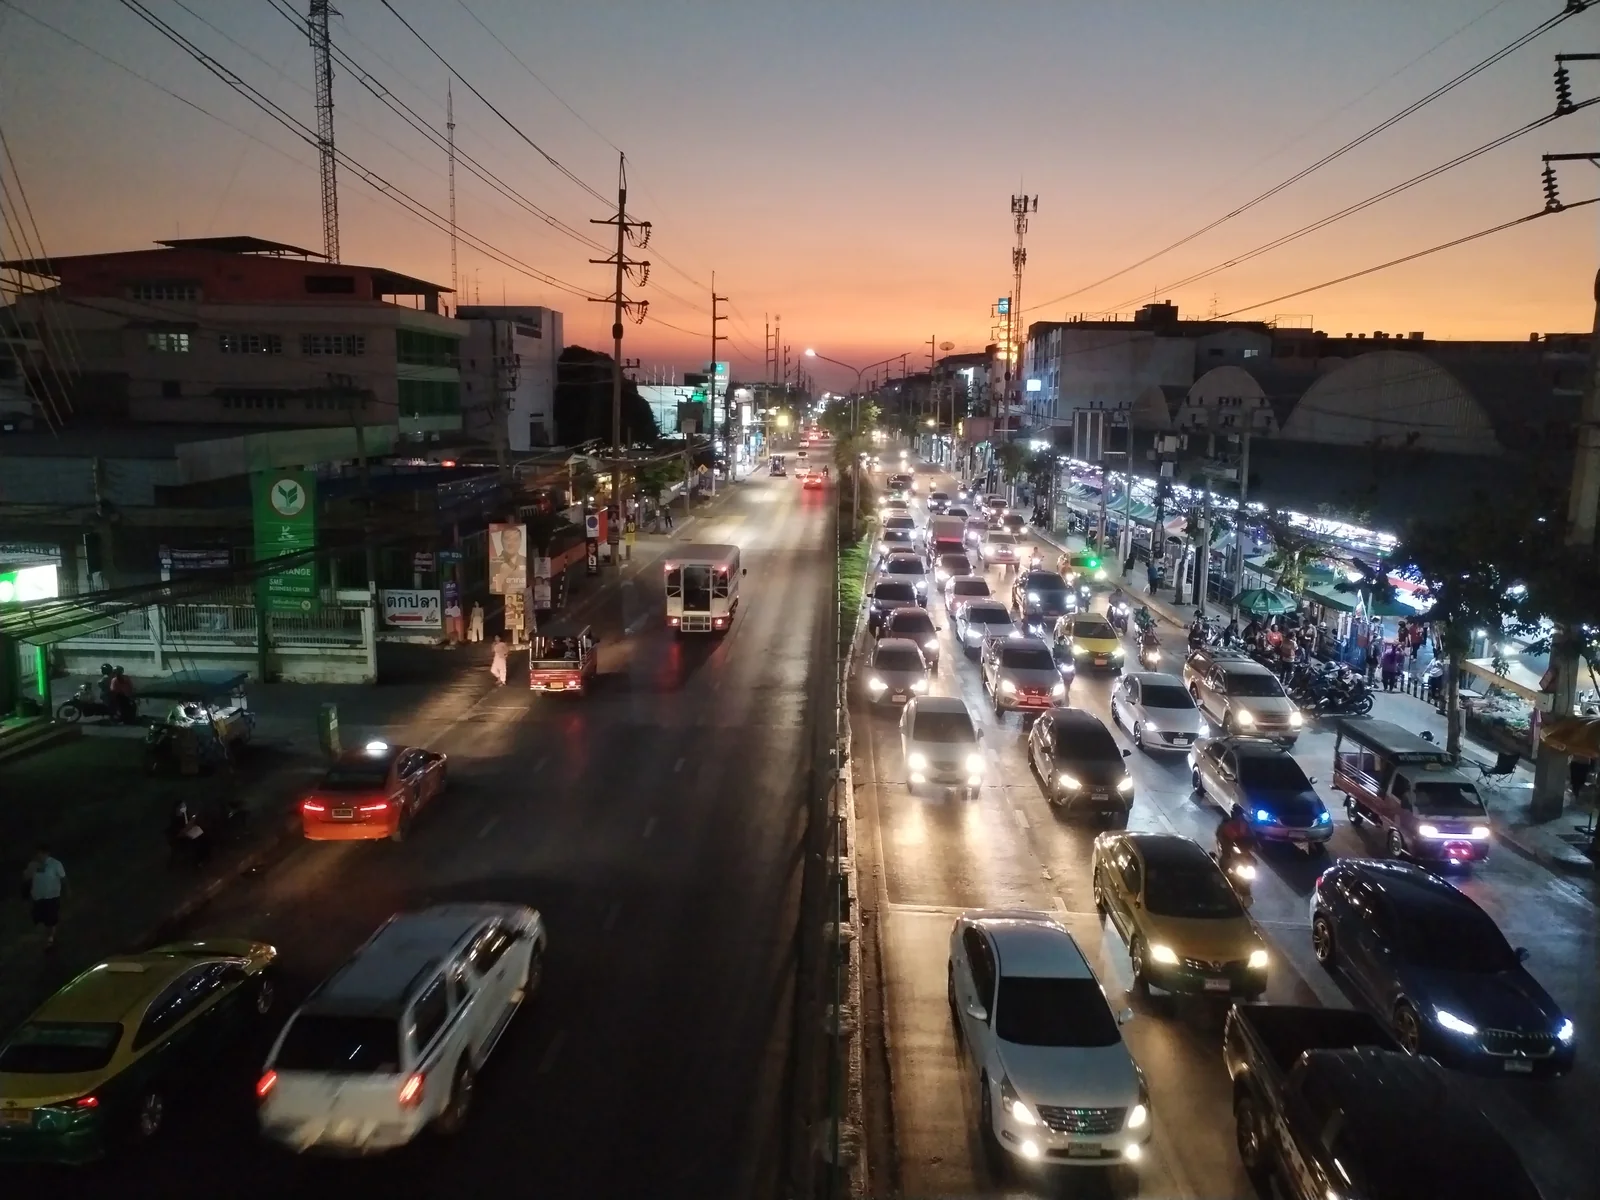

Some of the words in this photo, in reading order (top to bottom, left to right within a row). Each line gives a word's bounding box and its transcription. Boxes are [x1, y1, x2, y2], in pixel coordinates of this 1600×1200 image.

[627, 522, 635, 533] 10
[269, 578, 284, 586] SME
[387, 594, 438, 608] ตกปลา
